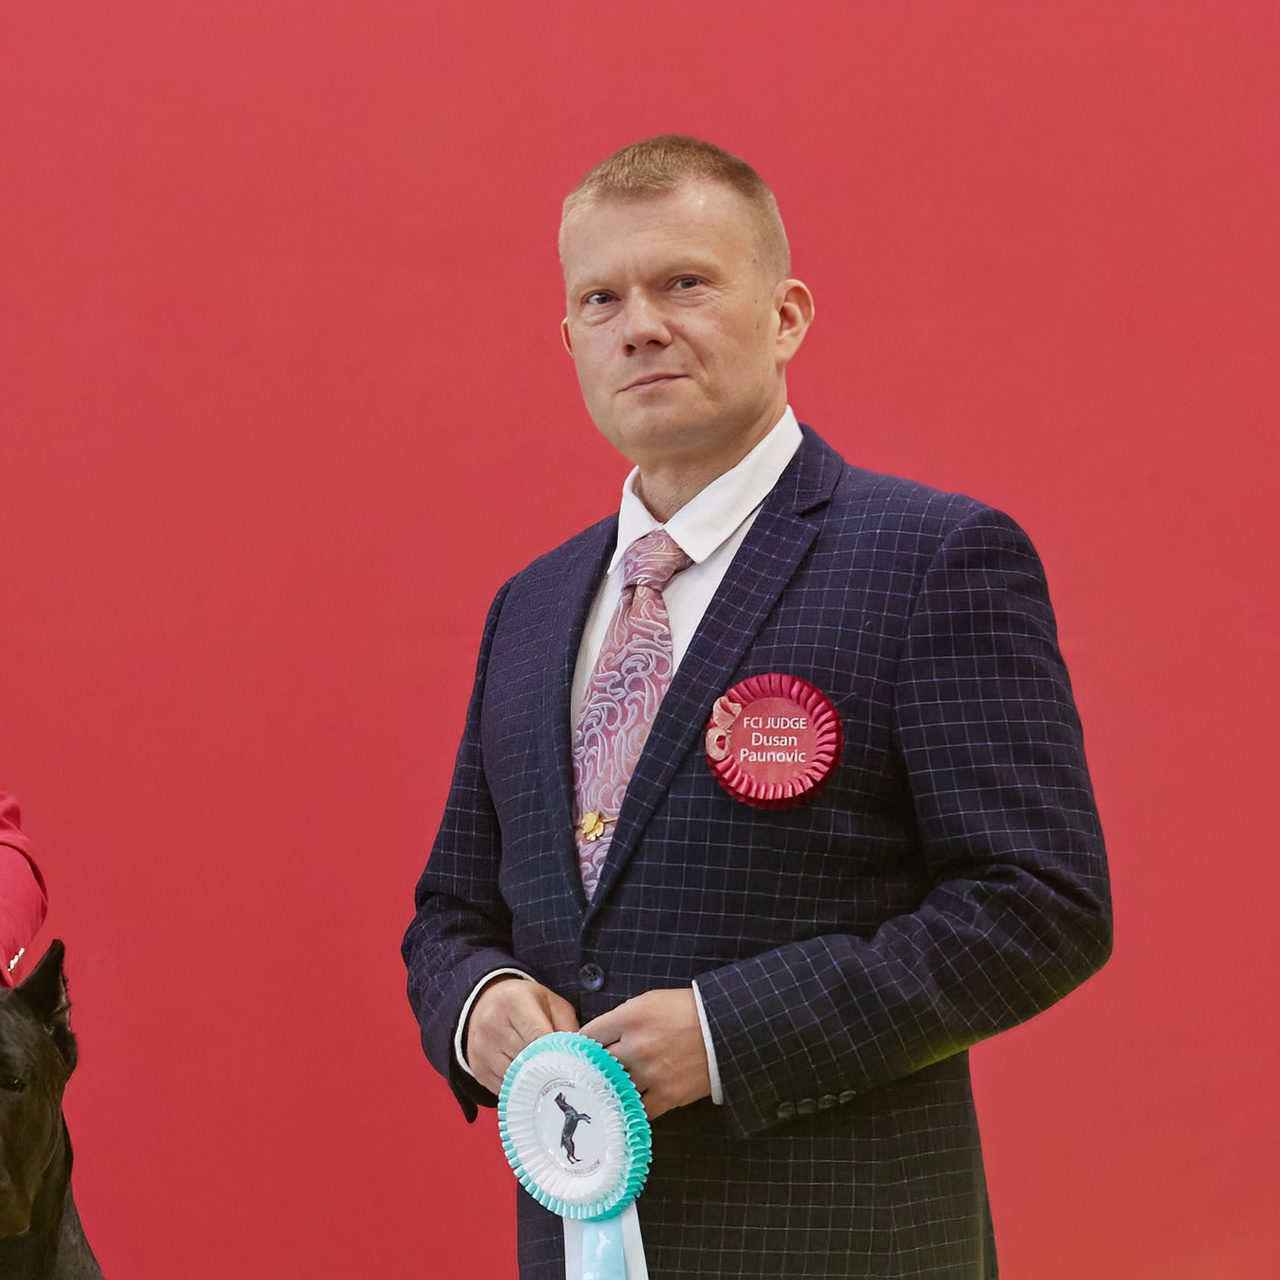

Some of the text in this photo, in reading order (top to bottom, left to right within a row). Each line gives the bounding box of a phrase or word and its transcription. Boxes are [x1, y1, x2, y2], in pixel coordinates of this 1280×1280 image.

[743, 717, 807, 729] FCI JUDGE
[752, 733, 797, 747] Dusan
[740, 748, 806, 763] Paunovic
